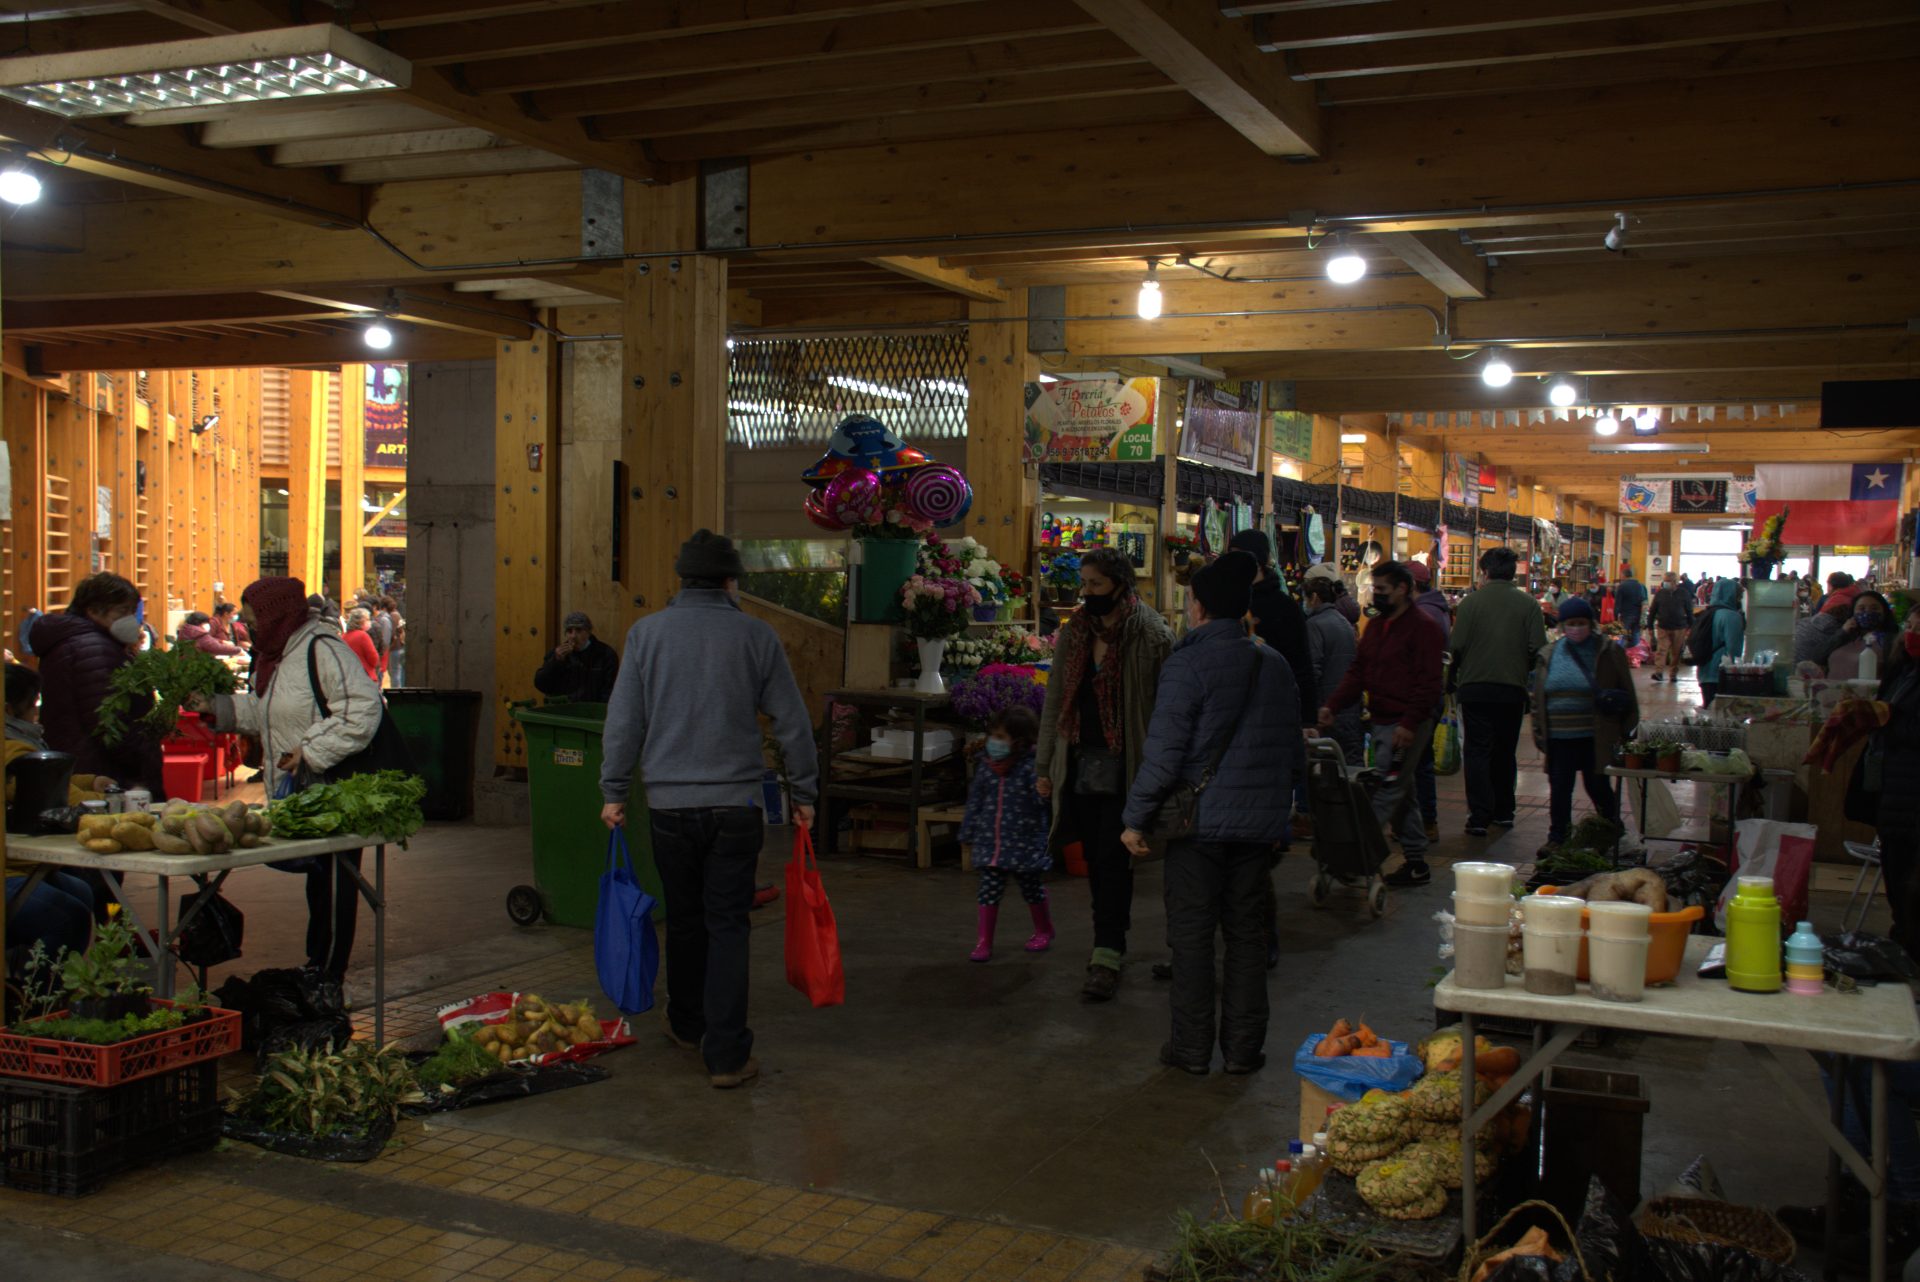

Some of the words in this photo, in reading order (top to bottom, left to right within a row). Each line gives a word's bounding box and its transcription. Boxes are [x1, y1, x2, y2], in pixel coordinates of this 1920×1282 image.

[1123, 433, 1151, 443] LOCAL
[1062, 447, 1067, 456] 9
[1130, 445, 1143, 457] 70
